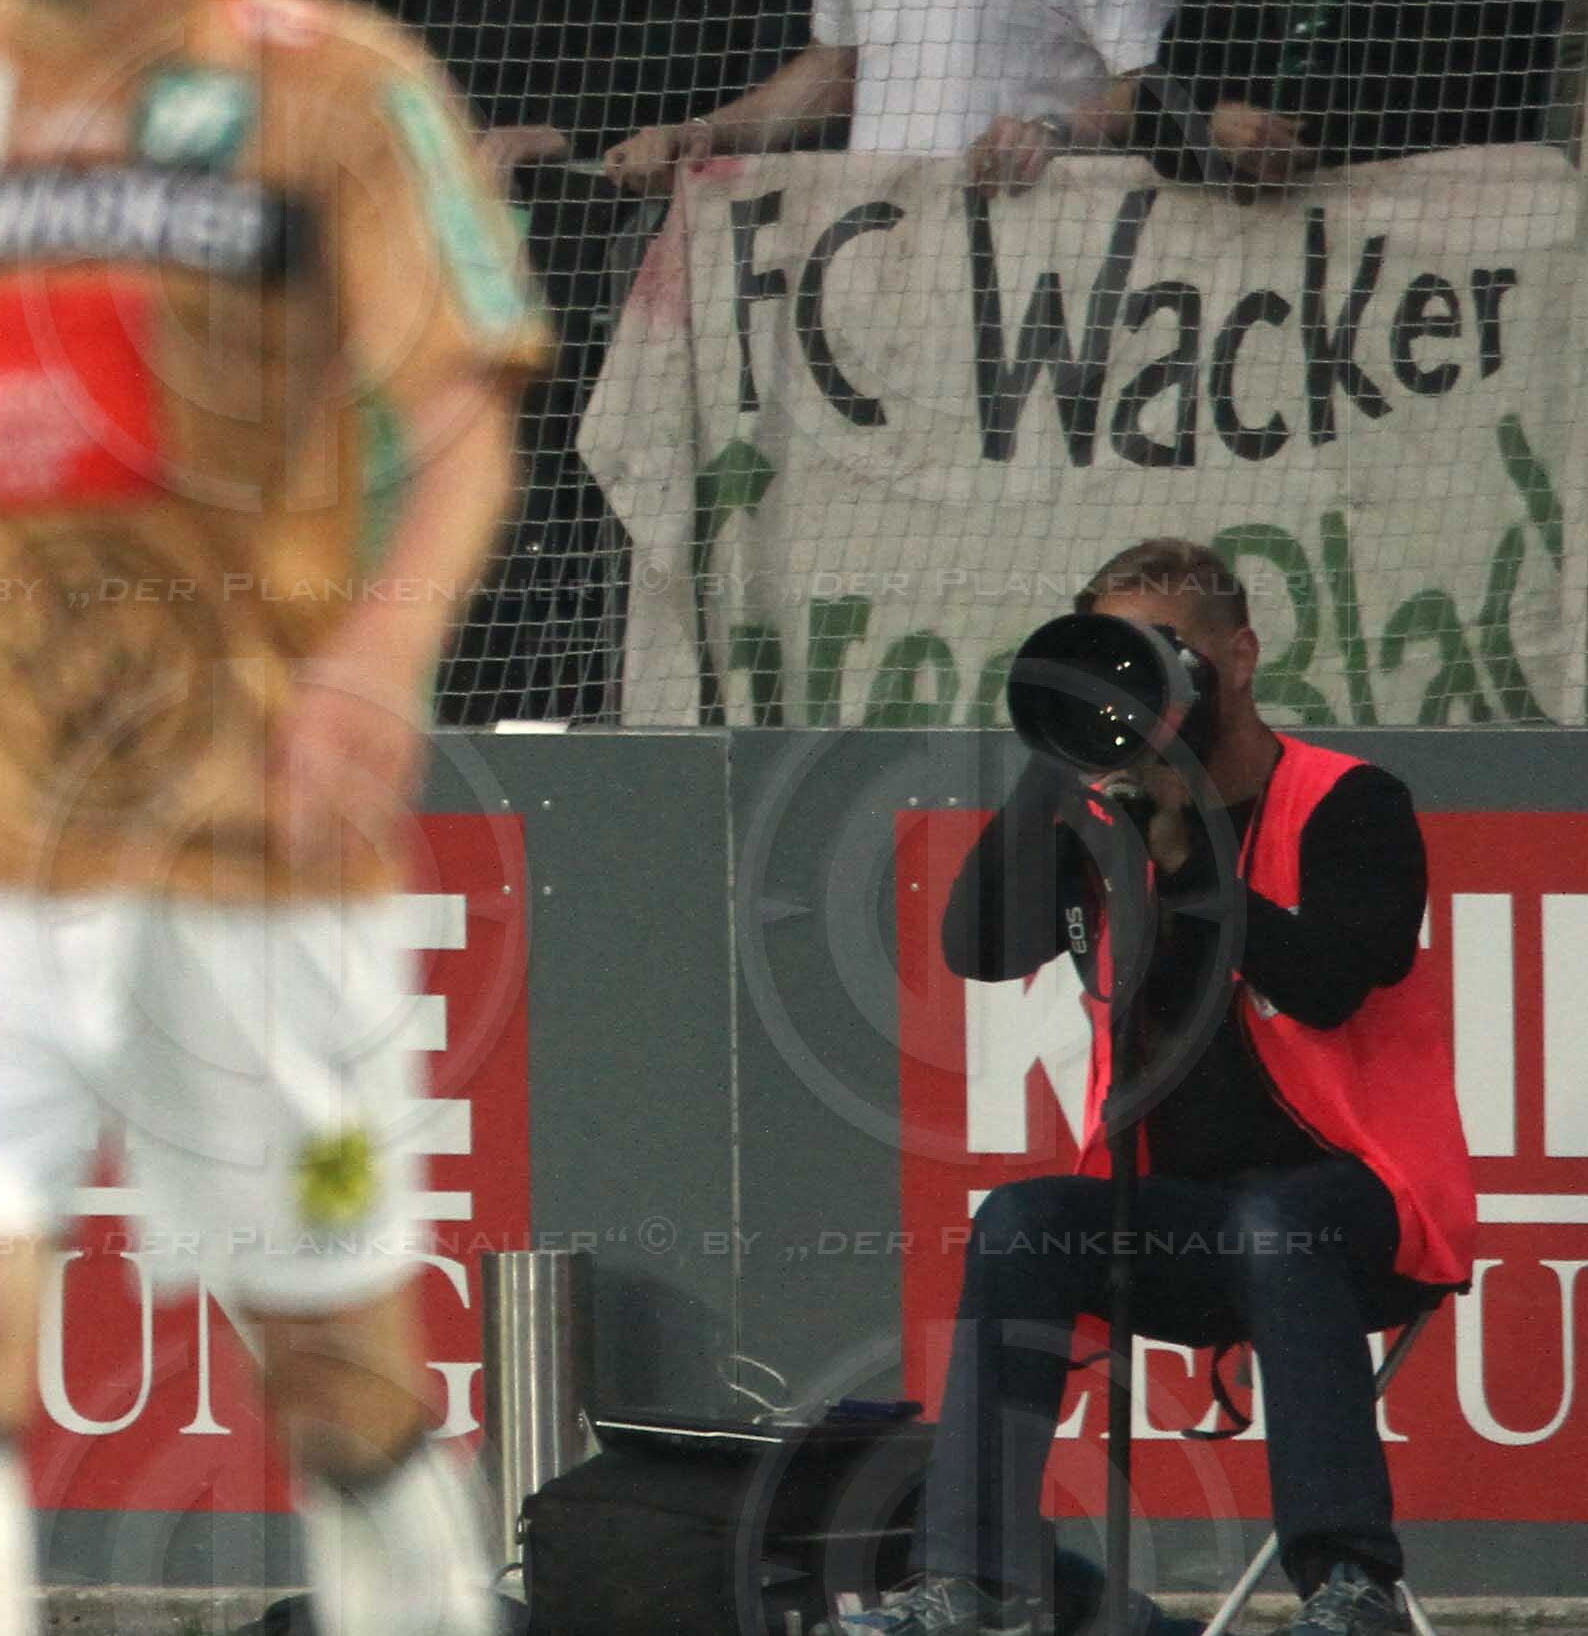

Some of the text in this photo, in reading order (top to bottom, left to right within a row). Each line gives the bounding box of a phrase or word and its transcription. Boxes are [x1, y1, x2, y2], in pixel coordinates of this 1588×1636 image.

[730, 187, 1518, 468] FC Wacker
[1065, 907, 1087, 954] EOS
